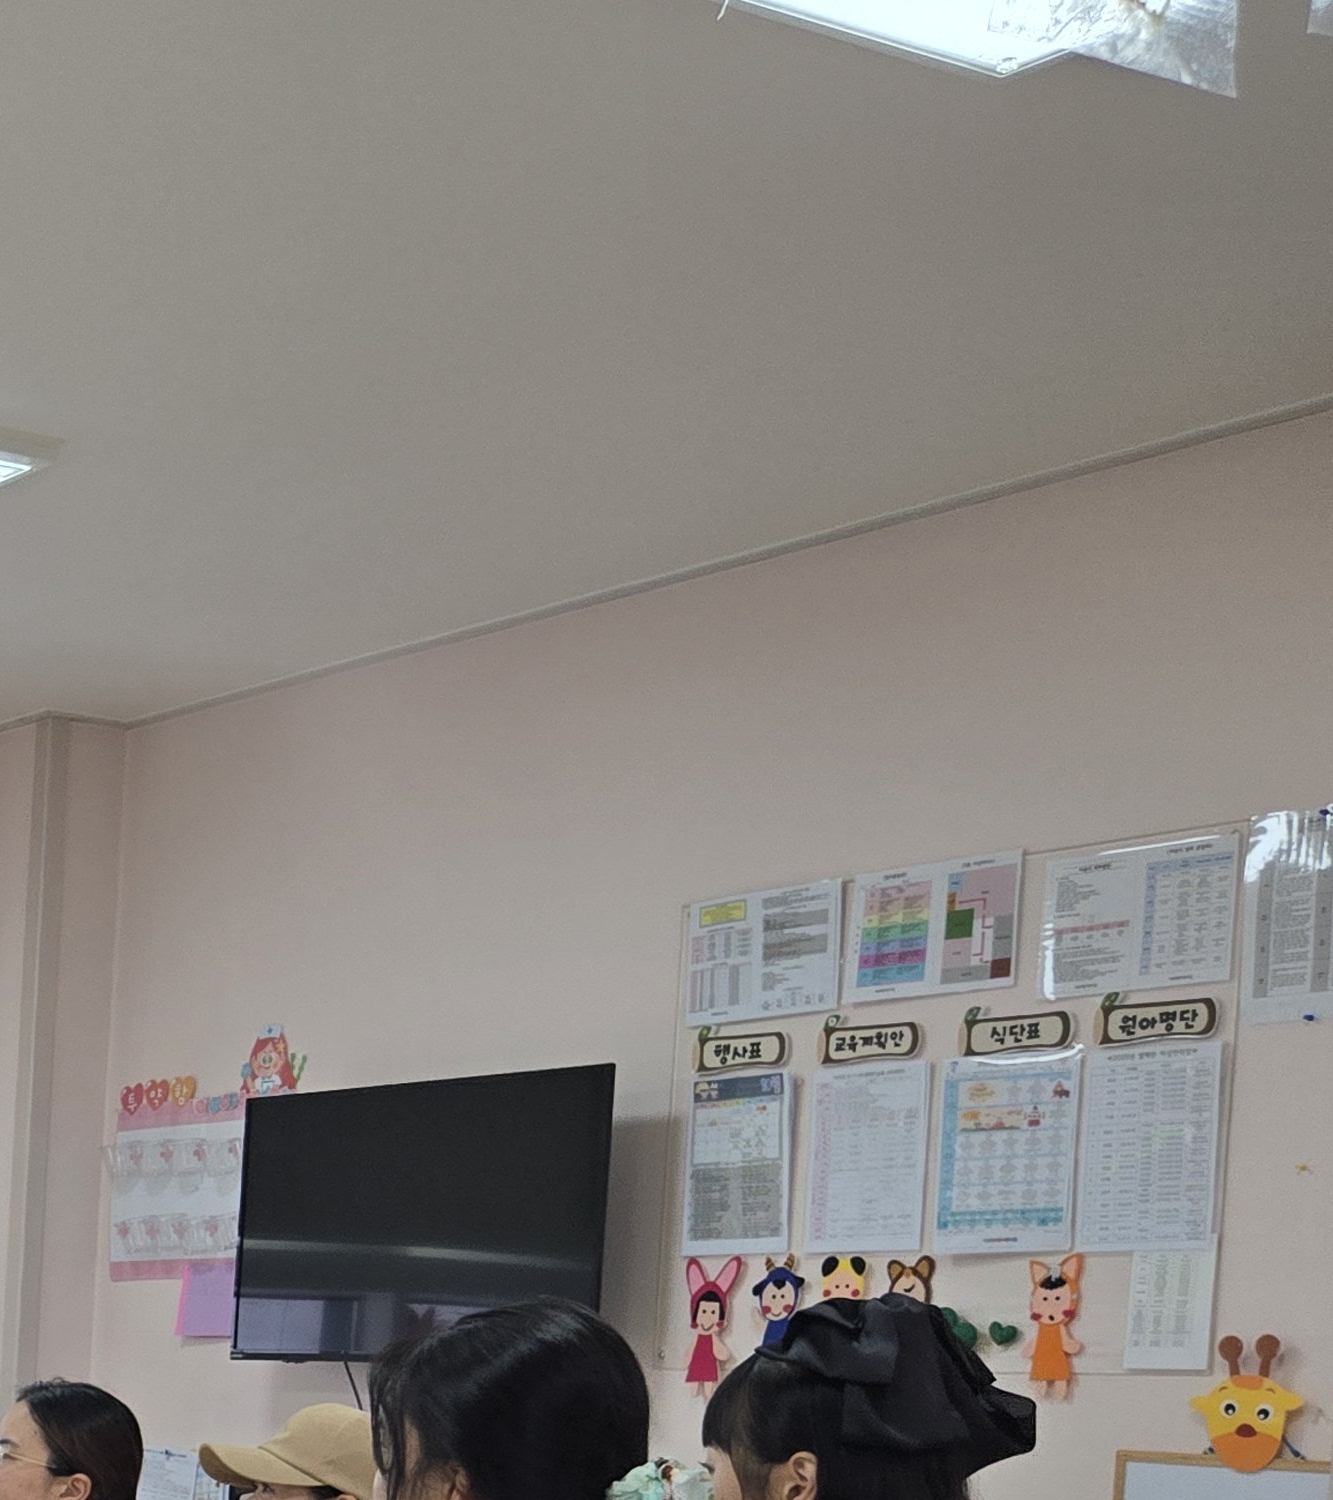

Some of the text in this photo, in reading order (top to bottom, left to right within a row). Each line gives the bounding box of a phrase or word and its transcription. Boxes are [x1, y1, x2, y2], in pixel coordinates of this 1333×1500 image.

[989, 1021, 1041, 1046] 식단표
[1117, 1009, 1199, 1036] 원아명단
[713, 1041, 762, 1066] 행사표
[834, 1030, 905, 1053] 교육계획안
